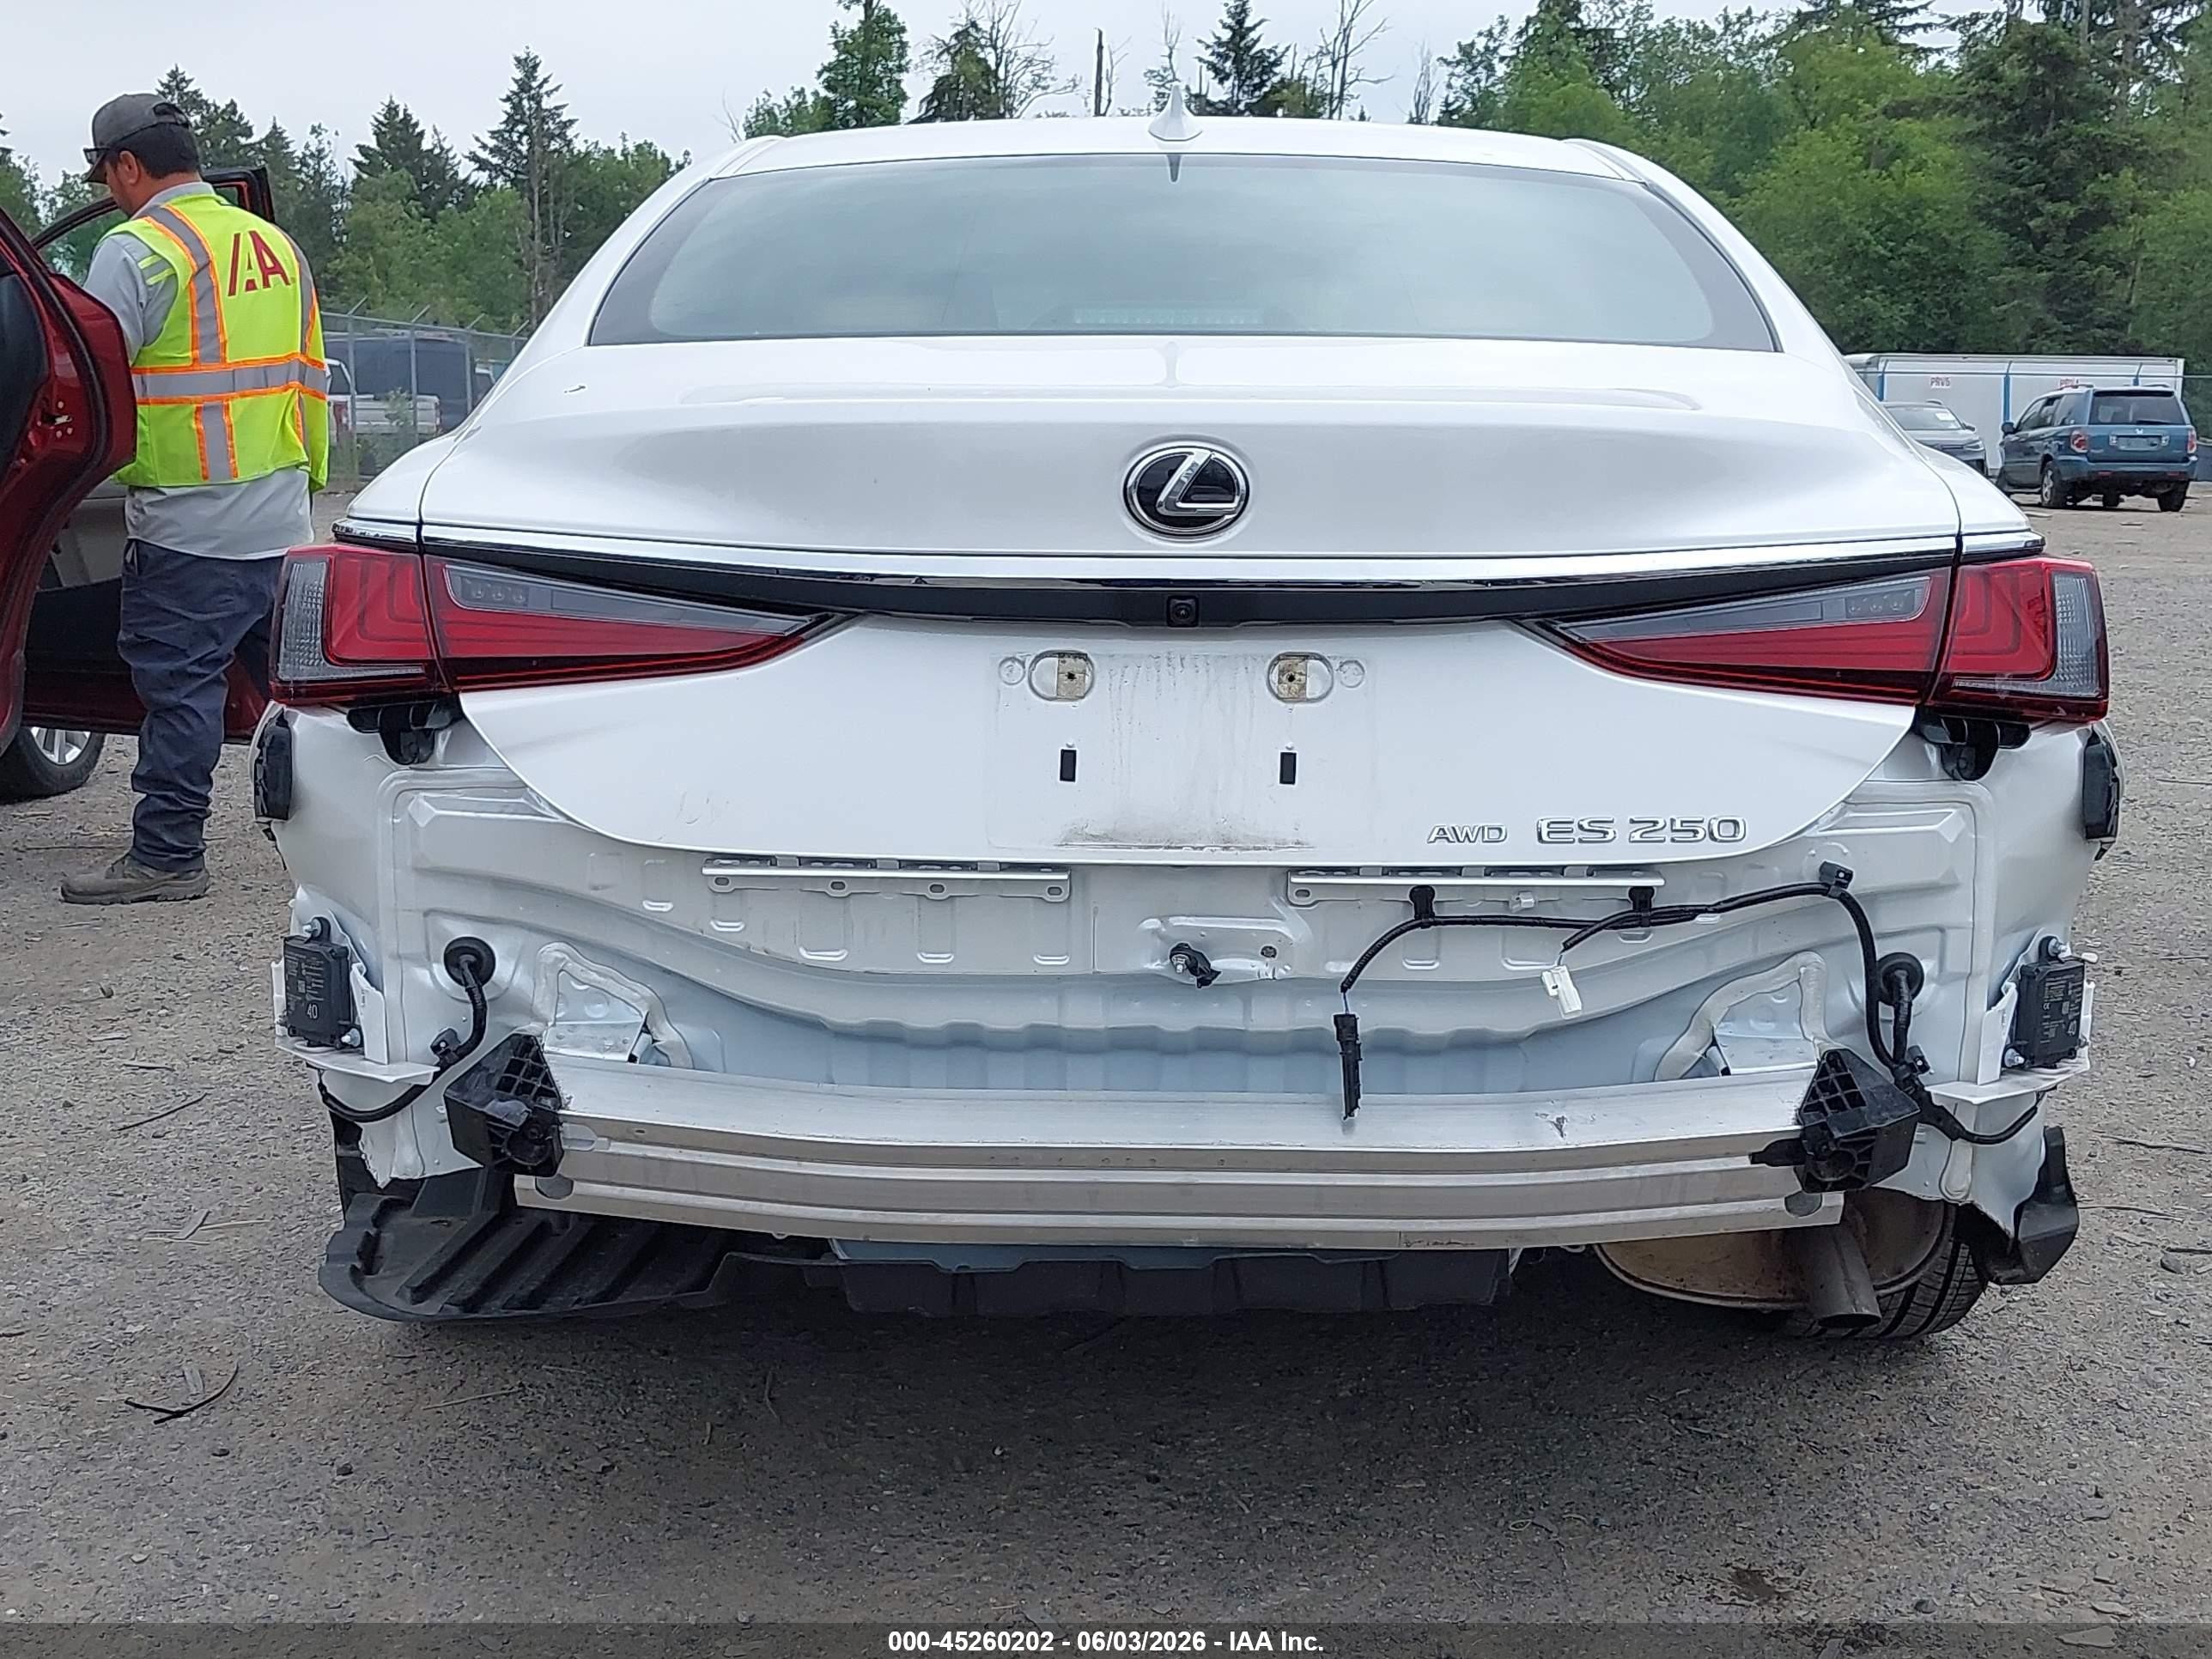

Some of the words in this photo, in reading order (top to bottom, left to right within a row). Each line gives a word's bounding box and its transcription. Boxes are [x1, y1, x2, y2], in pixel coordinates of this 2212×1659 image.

[1426, 824, 1508, 844] AWD
[1536, 817, 1617, 844] ES
[1628, 816, 1747, 843] 250
